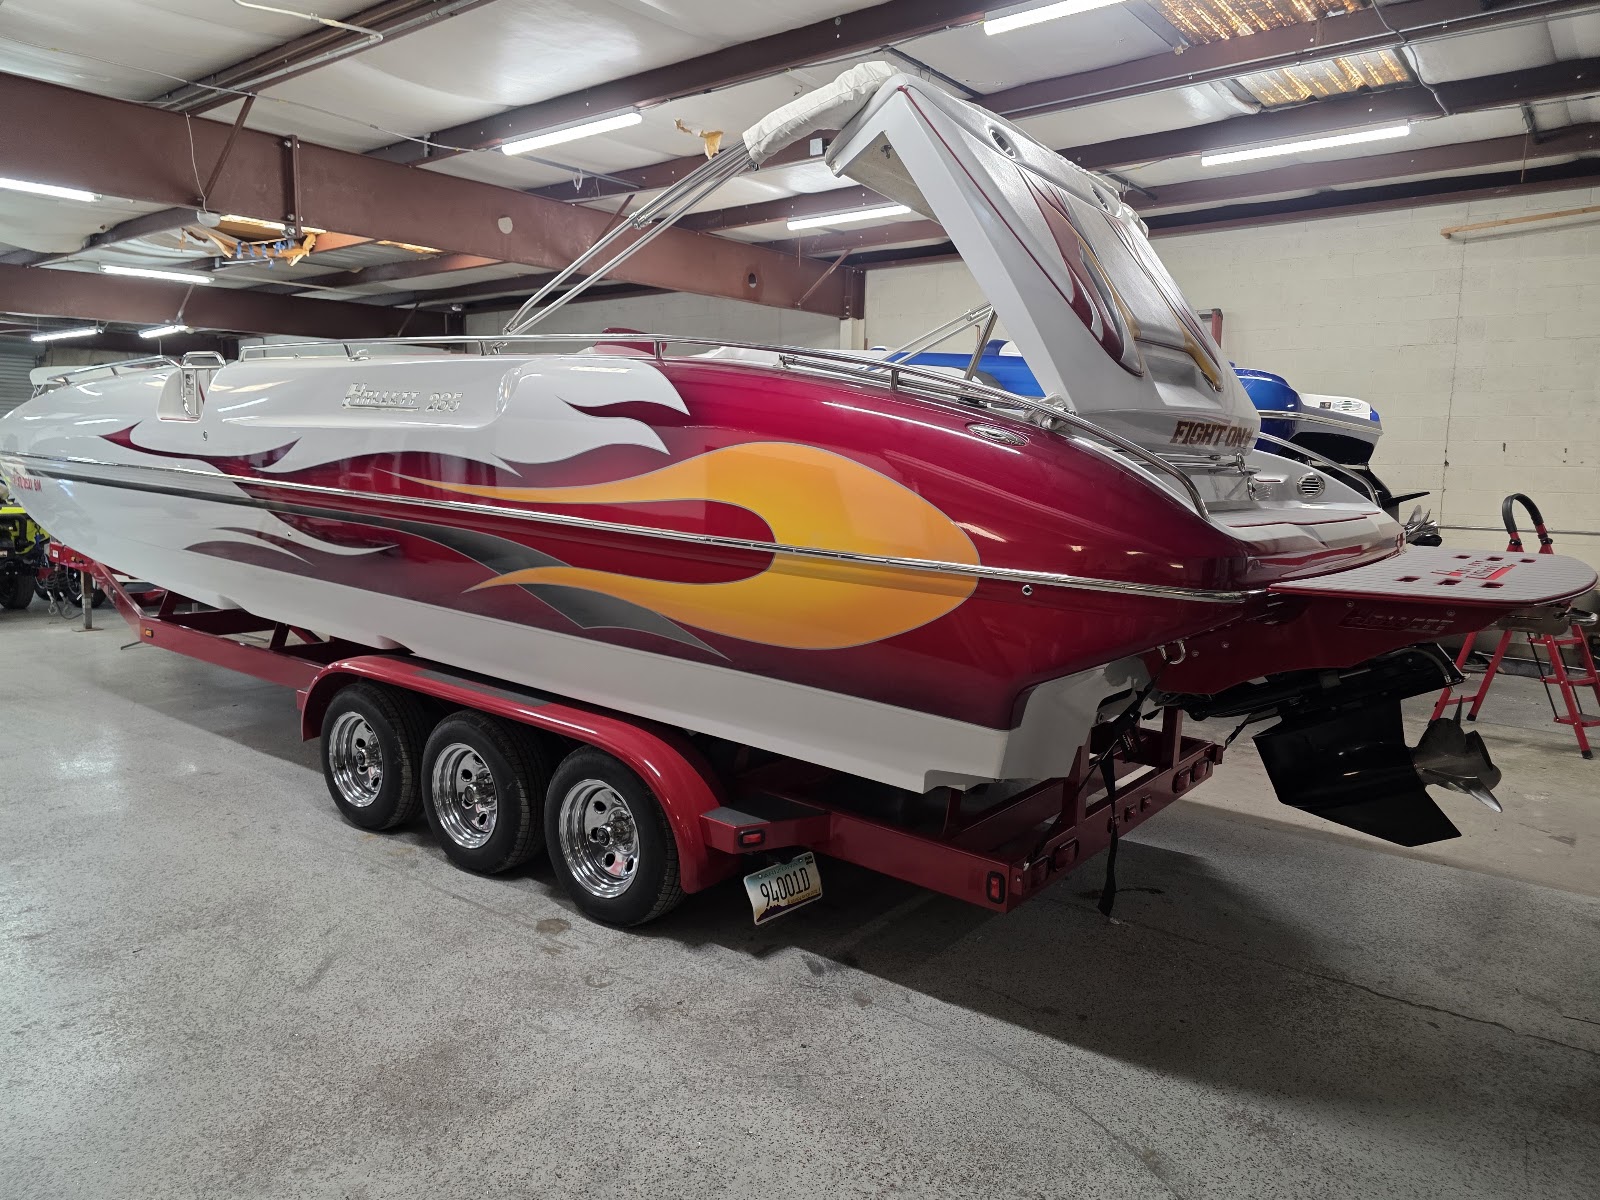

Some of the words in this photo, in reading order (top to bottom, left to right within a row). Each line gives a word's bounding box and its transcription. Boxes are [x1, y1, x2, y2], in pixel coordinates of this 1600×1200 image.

[1169, 420, 1227, 446] FIGHT
[1224, 425, 1248, 448] ON
[759, 867, 811, 908] 94001D
